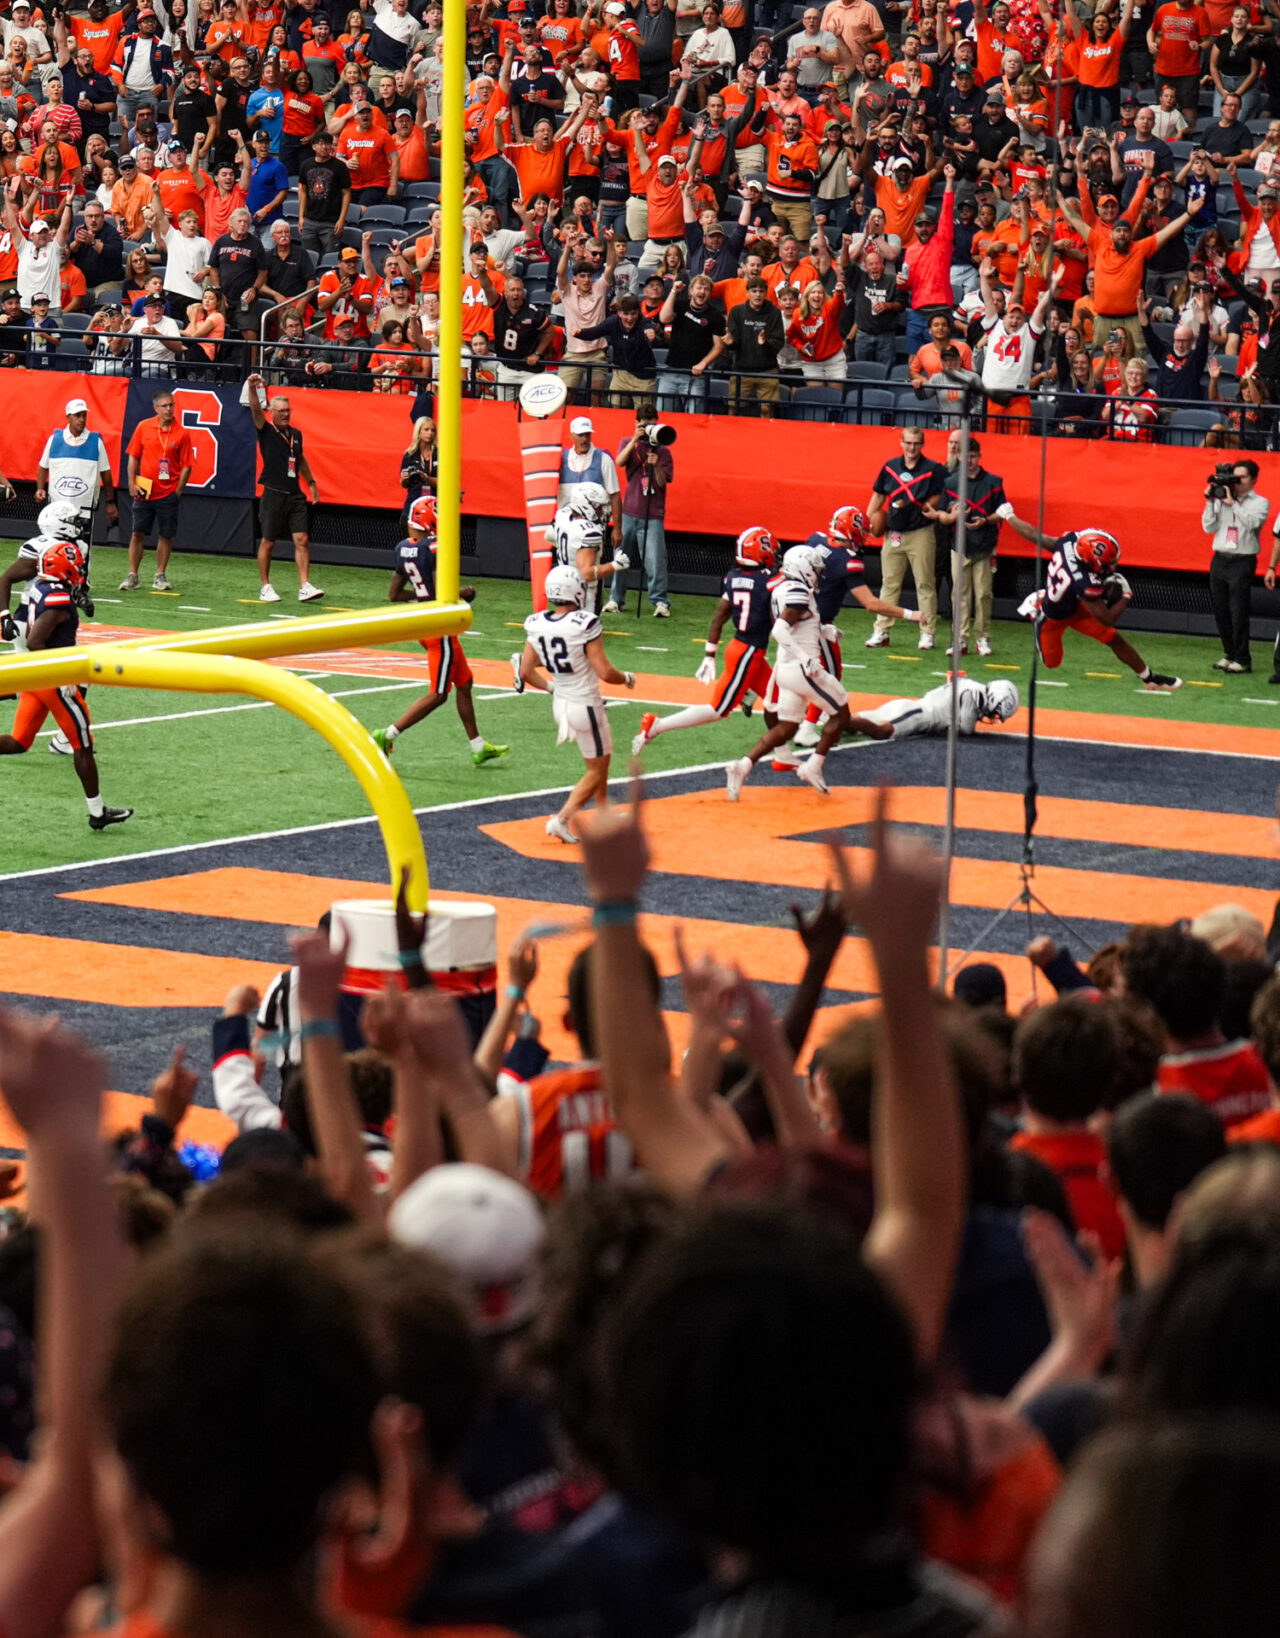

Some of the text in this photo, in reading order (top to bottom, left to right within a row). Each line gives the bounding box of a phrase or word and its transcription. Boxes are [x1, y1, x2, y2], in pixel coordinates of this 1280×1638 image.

[82, 28, 110, 41] Syracuse
[346, 138, 375, 150] Syracuse
[219, 245, 252, 257] SYRACUSE
[462, 285, 488, 307] 44
[504, 329, 518, 351] 8
[993, 335, 1021, 363] 44
[530, 387, 557, 398] ACC
[59, 479, 83, 490] ACC
[852, 513, 864, 530] S
[760, 535, 771, 551] S
[1092, 542, 1107, 558] S
[64, 547, 76, 561] S
[404, 562, 430, 598] 2
[1046, 551, 1072, 603] 23
[570, 612, 587, 626] 12
[732, 591, 751, 632] 7
[538, 636, 574, 675] 12
